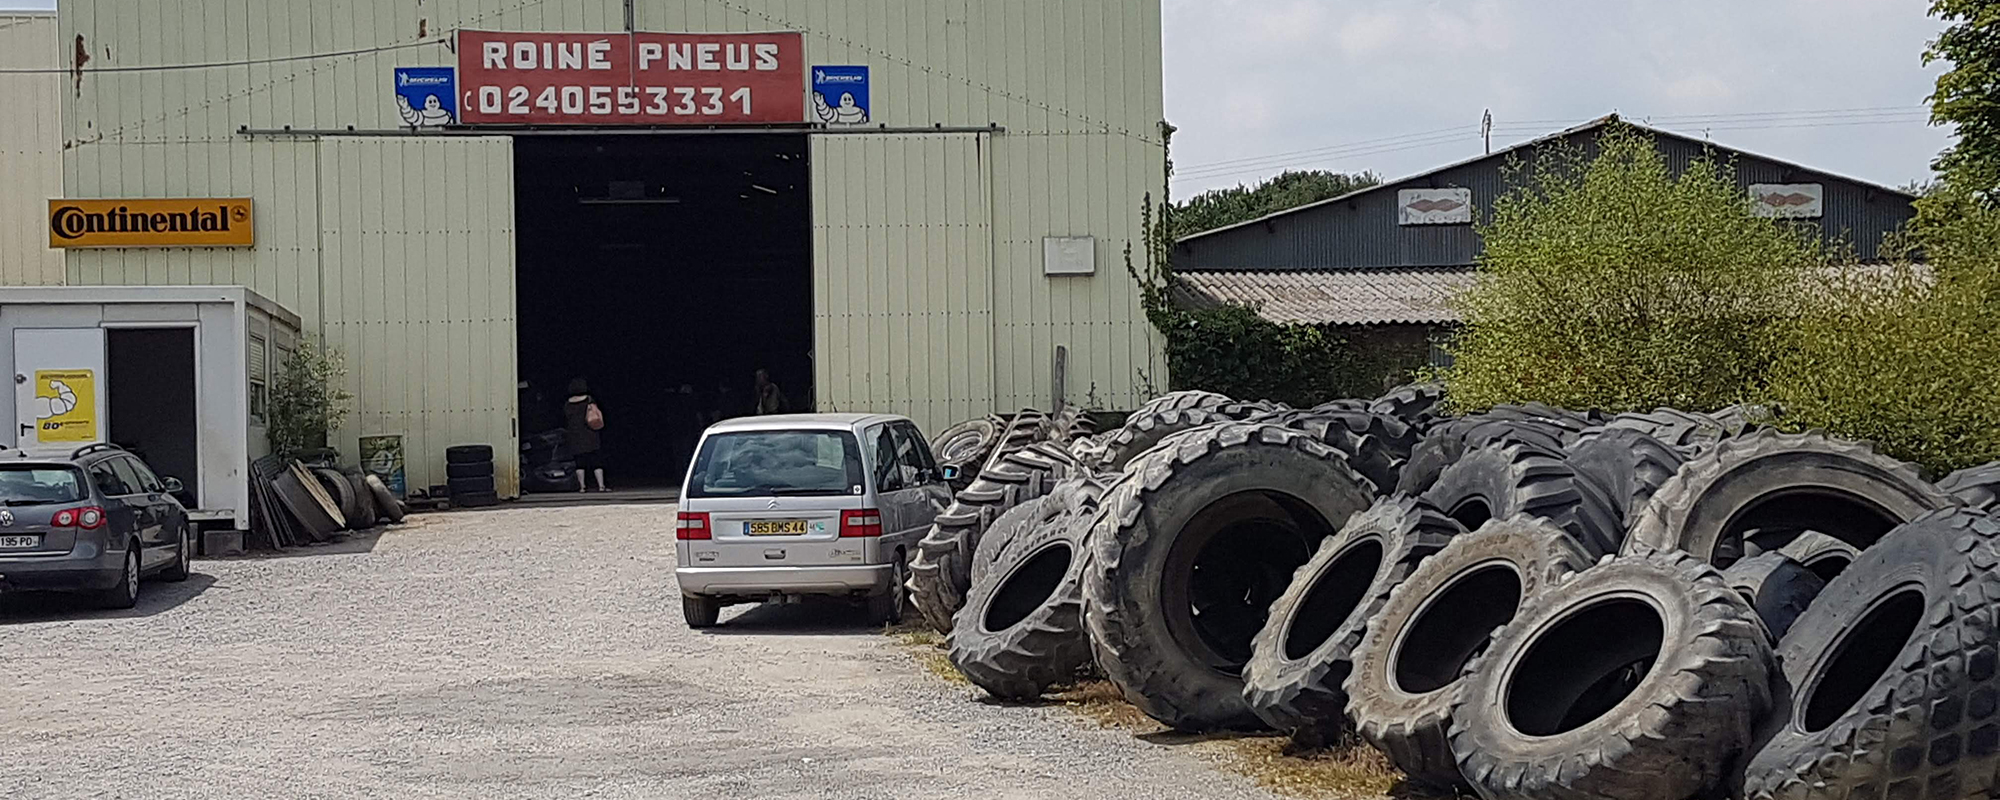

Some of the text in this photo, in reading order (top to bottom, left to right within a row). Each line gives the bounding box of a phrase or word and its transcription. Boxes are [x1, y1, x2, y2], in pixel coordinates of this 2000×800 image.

[483, 38, 779, 71] ROINÉ PNEUS
[51, 205, 230, 240] Continental
